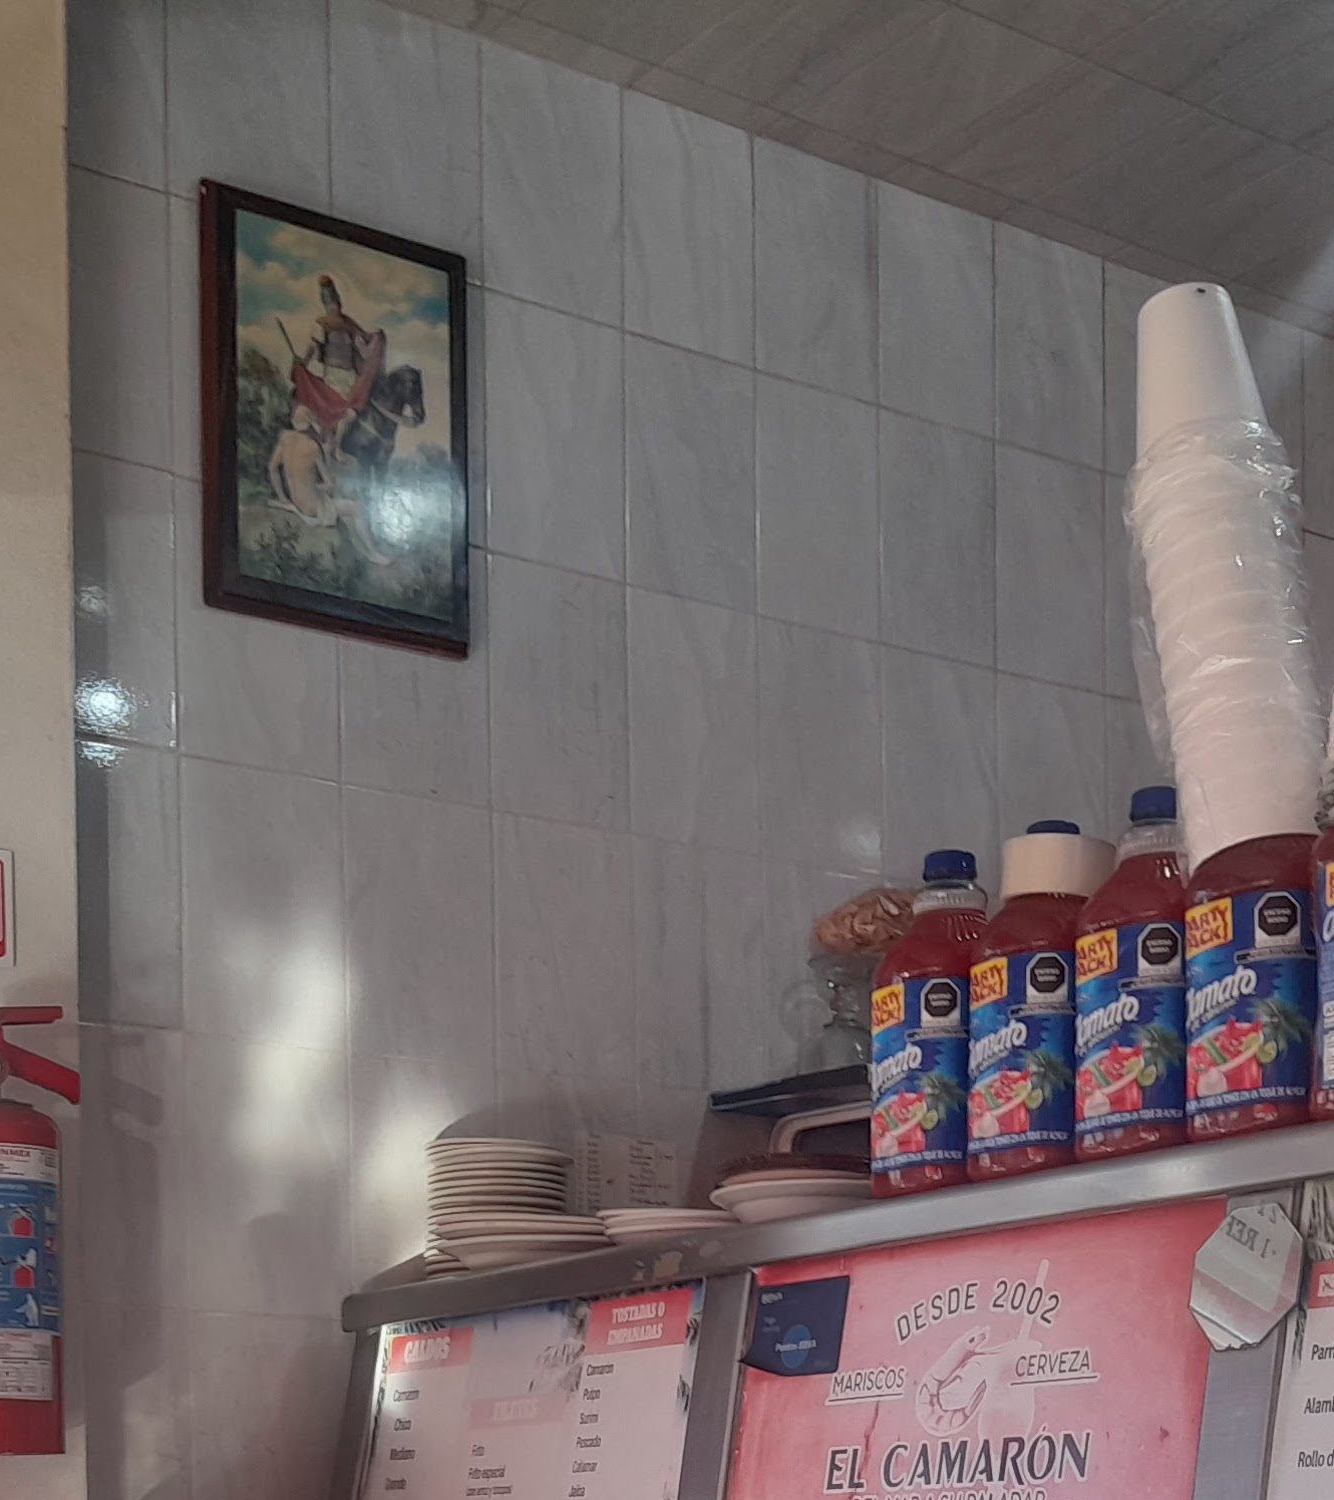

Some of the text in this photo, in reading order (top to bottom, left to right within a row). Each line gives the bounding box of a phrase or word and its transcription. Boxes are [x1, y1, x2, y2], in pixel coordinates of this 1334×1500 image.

[895, 1278, 1061, 1343] DESDE 2002
[831, 1349, 1091, 1395] MARISCOS CERVEZA
[825, 1422, 1092, 1491] EL CAMARÓN
[1297, 1449, 1326, 1469] Rollo
